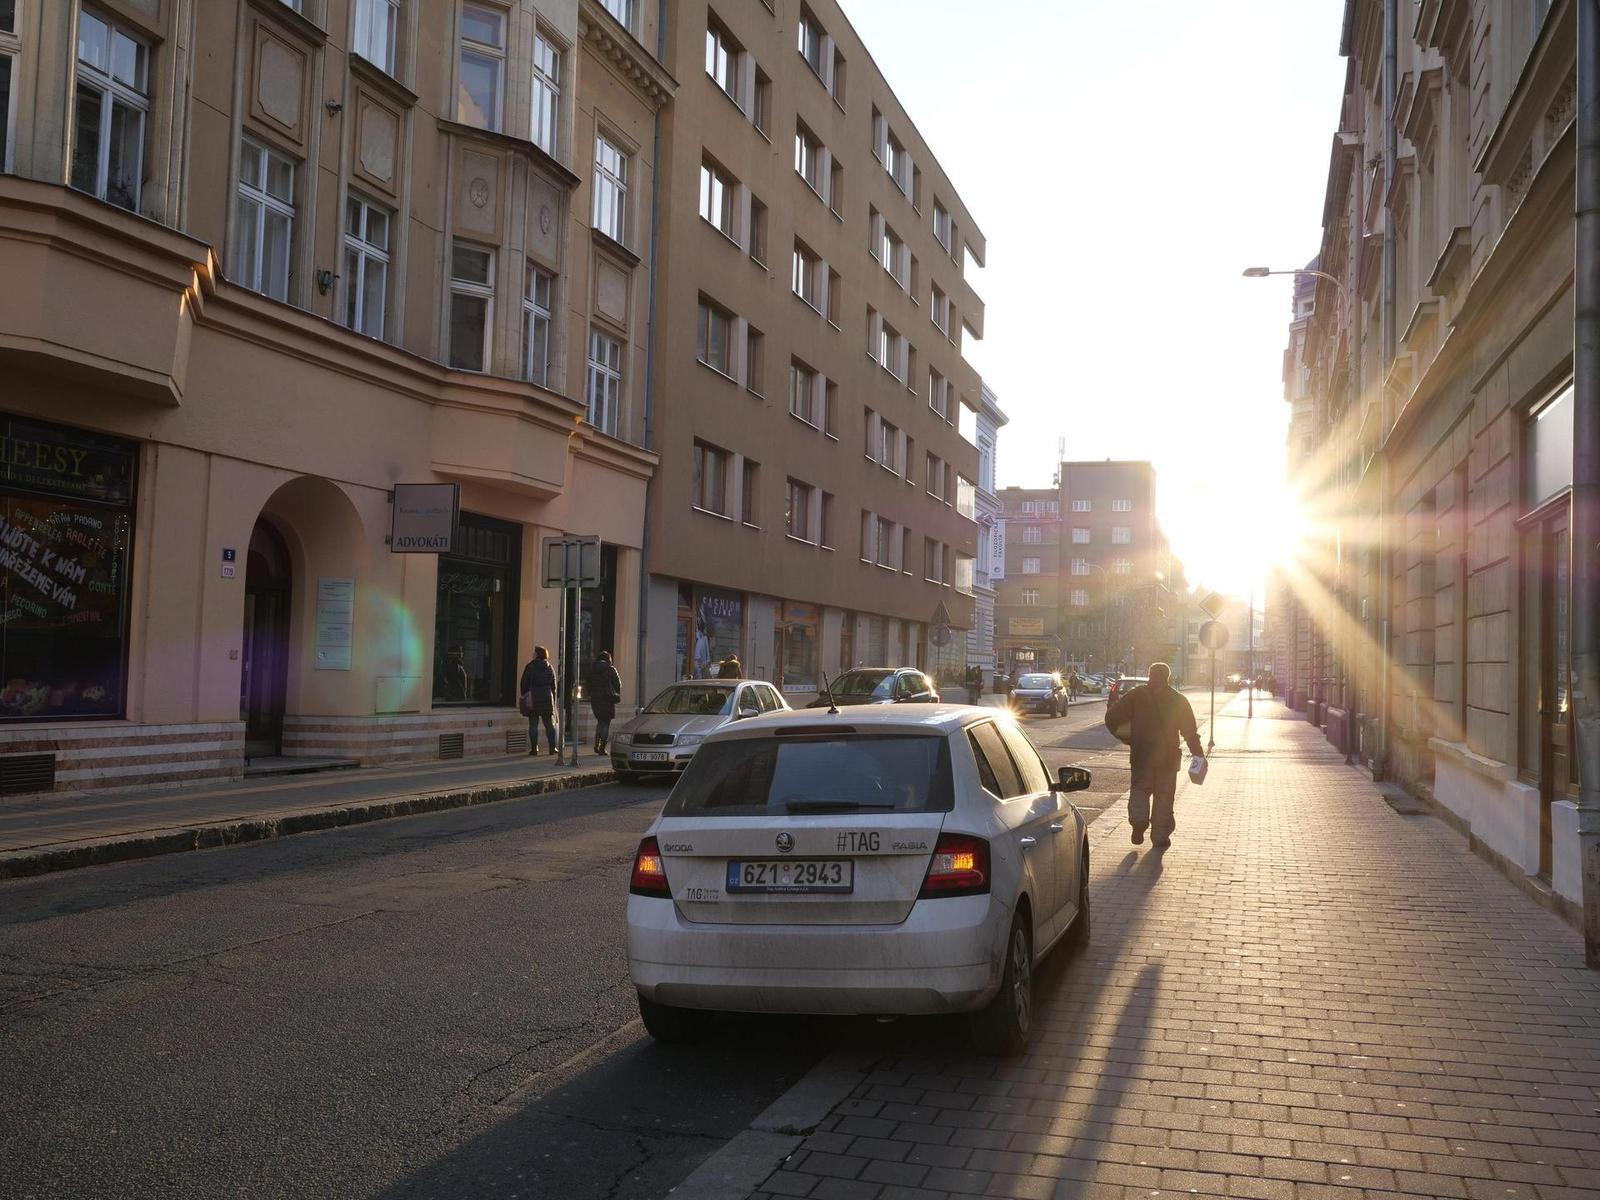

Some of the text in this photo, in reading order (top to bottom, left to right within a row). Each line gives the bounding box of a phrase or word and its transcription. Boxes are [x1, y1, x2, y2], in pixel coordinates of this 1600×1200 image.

[396, 534, 449, 548] ADVOKÁTI
[41, 548, 56, 568] K
[55, 557, 87, 585] NÁM
[52, 585, 77, 610] VÁM
[837, 831, 880, 852] #TAG
[891, 841, 928, 850] FABIA
[744, 863, 842, 884] 6Z1 2943
[687, 888, 702, 899] TAG
